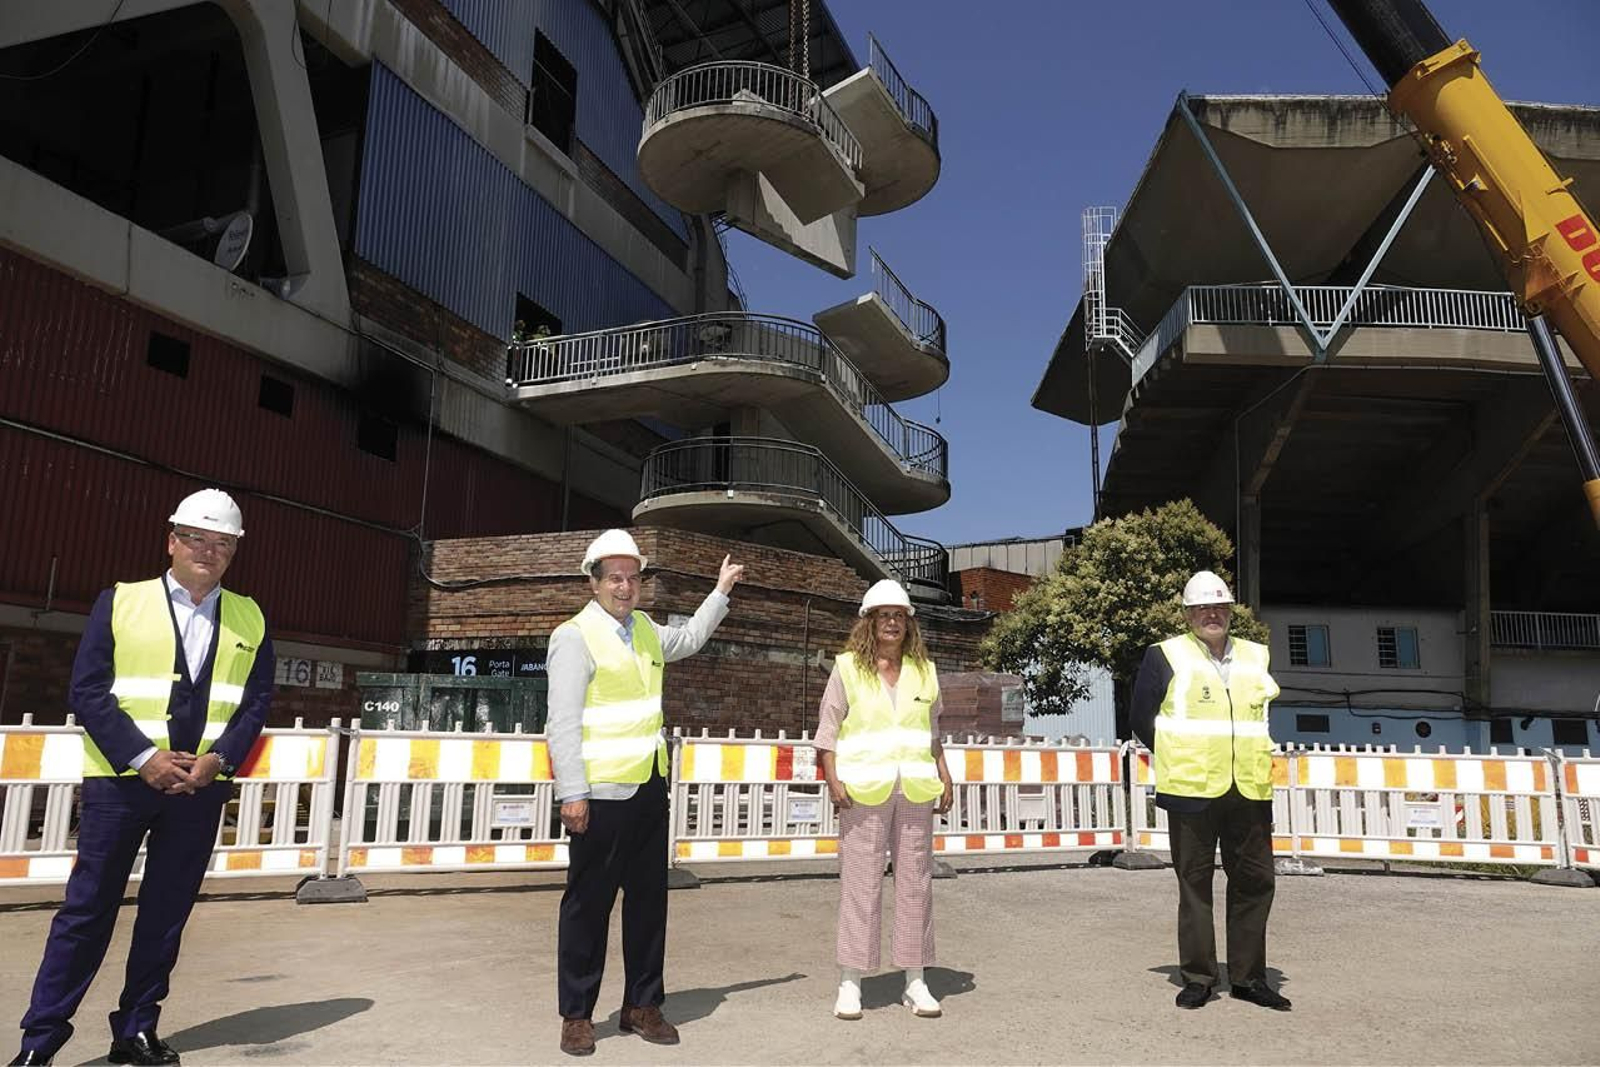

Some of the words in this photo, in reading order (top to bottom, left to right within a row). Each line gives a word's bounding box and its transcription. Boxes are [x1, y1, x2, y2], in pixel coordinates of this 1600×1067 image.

[452, 656, 477, 676] 16
[489, 660, 511, 669] Porta
[520, 663, 549, 671] ABANC
[283, 659, 309, 684] 16
[490, 669, 510, 678] Gate
[364, 700, 400, 713] C140
